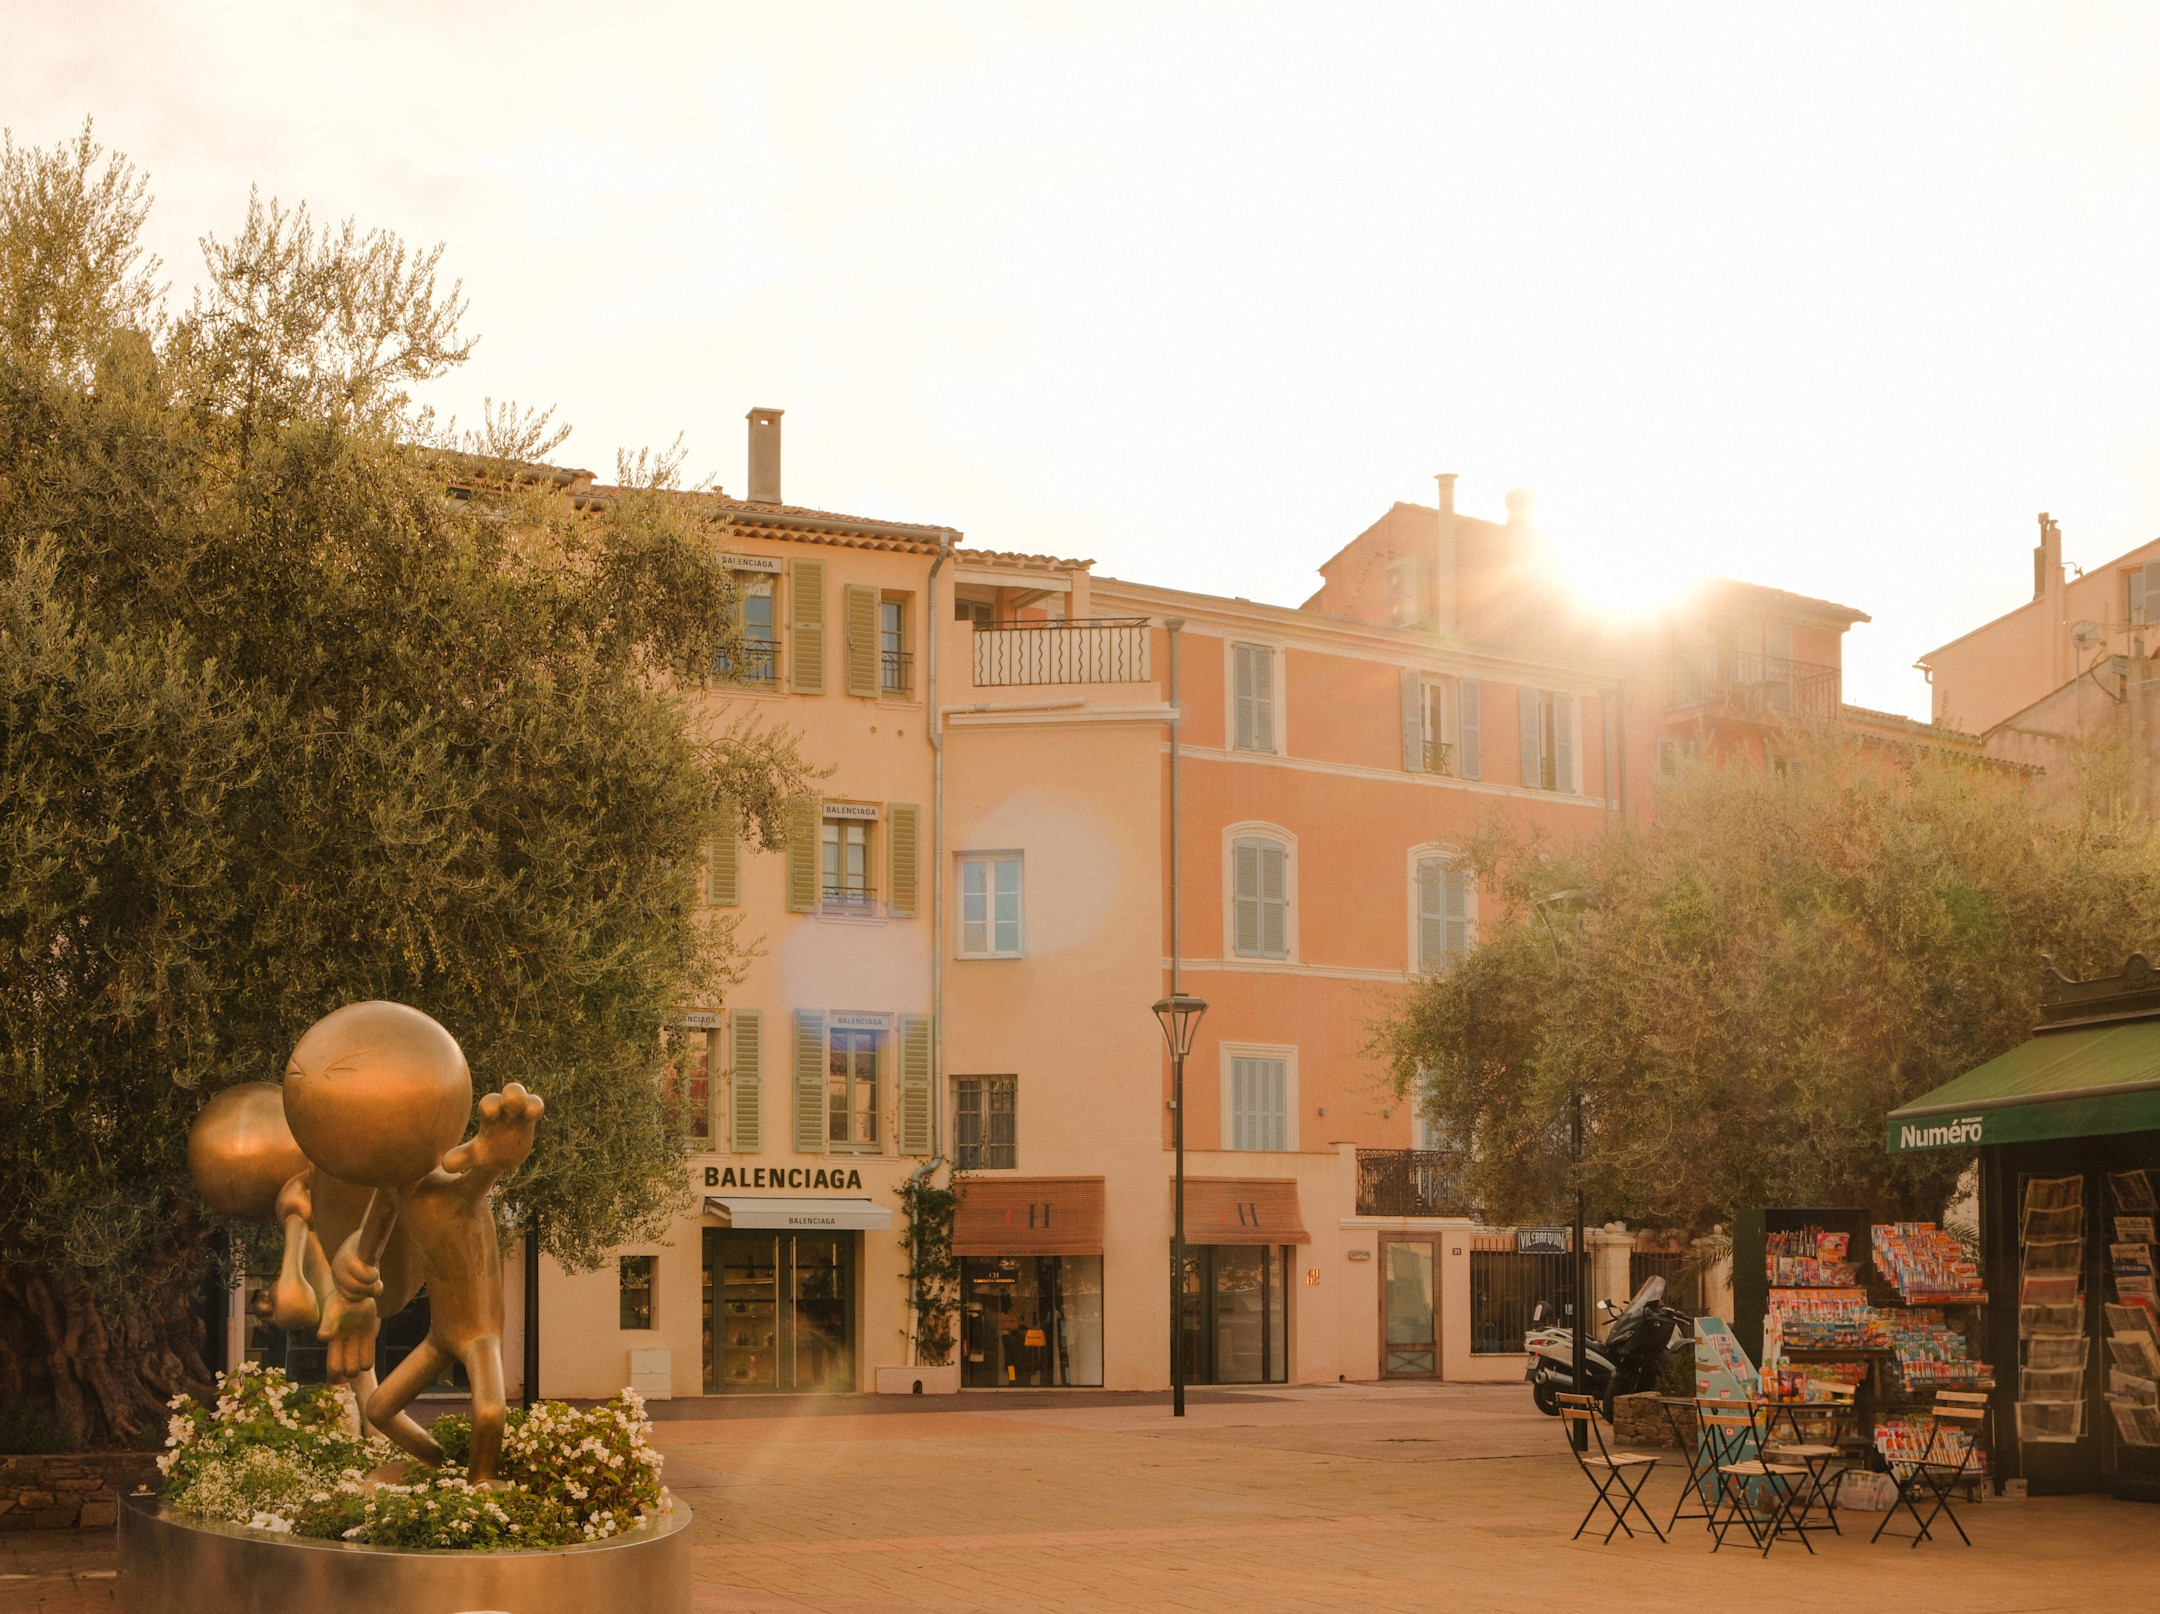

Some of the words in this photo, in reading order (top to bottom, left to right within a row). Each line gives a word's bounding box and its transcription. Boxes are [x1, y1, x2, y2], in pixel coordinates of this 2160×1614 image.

[826, 806, 876, 816] BALENCIAGA
[837, 1017, 882, 1026] BALENCIAGA
[1900, 1119, 1983, 1149] Numéro
[704, 1166, 862, 1189] BALENCIAGA
[788, 1217, 836, 1225] BALENCIAGA
[1005, 1202, 1052, 1230] CH
